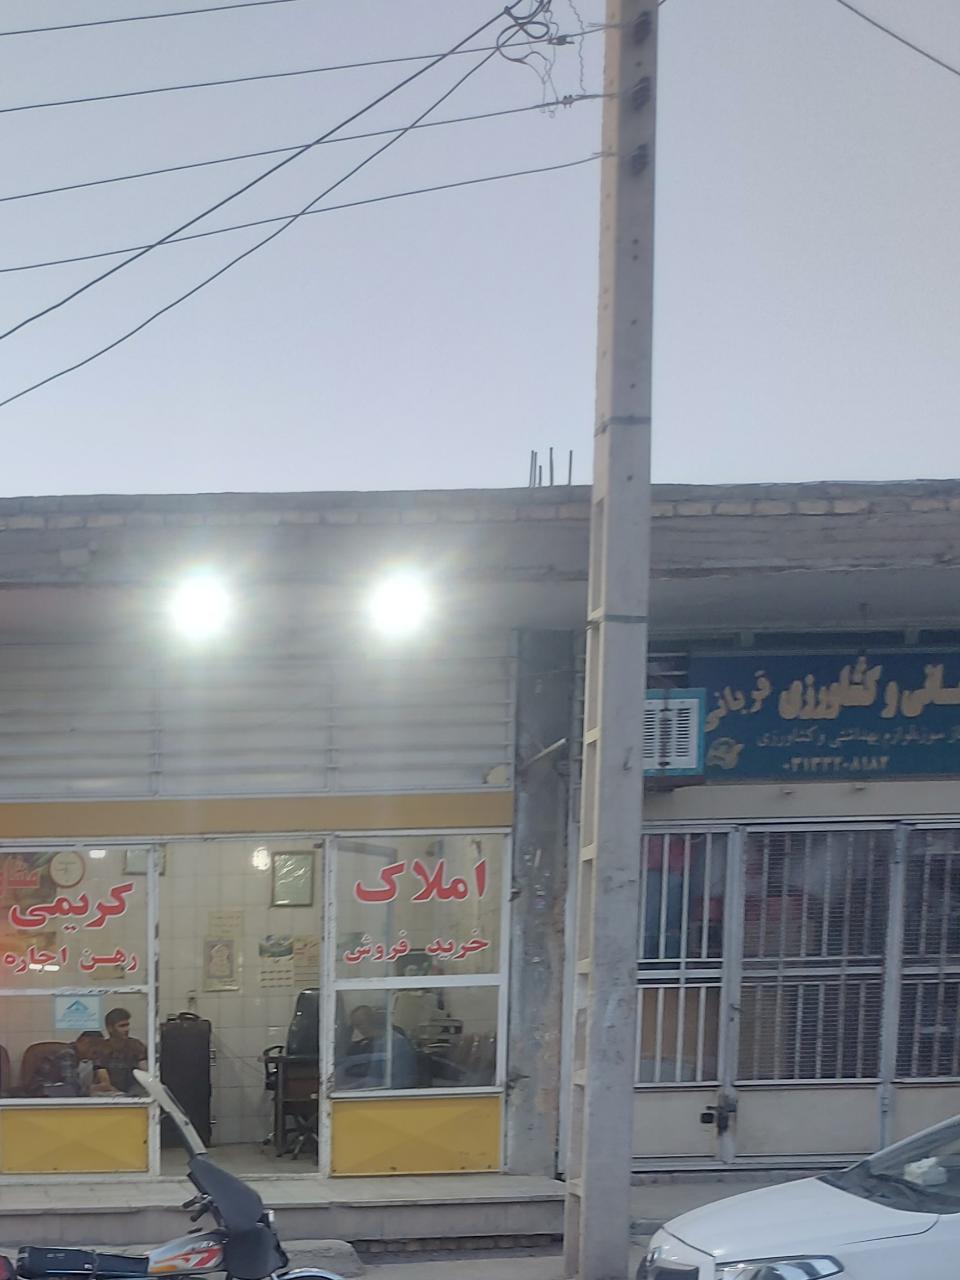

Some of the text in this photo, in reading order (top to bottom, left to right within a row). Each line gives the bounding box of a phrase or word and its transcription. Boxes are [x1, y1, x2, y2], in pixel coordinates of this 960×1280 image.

[355, 857, 488, 904] املاک
[8, 882, 135, 933] کریمی
[3, 945, 139, 975] رهن اجاره
[343, 929, 410, 964] فروش
[424, 928, 490, 960] خرید
